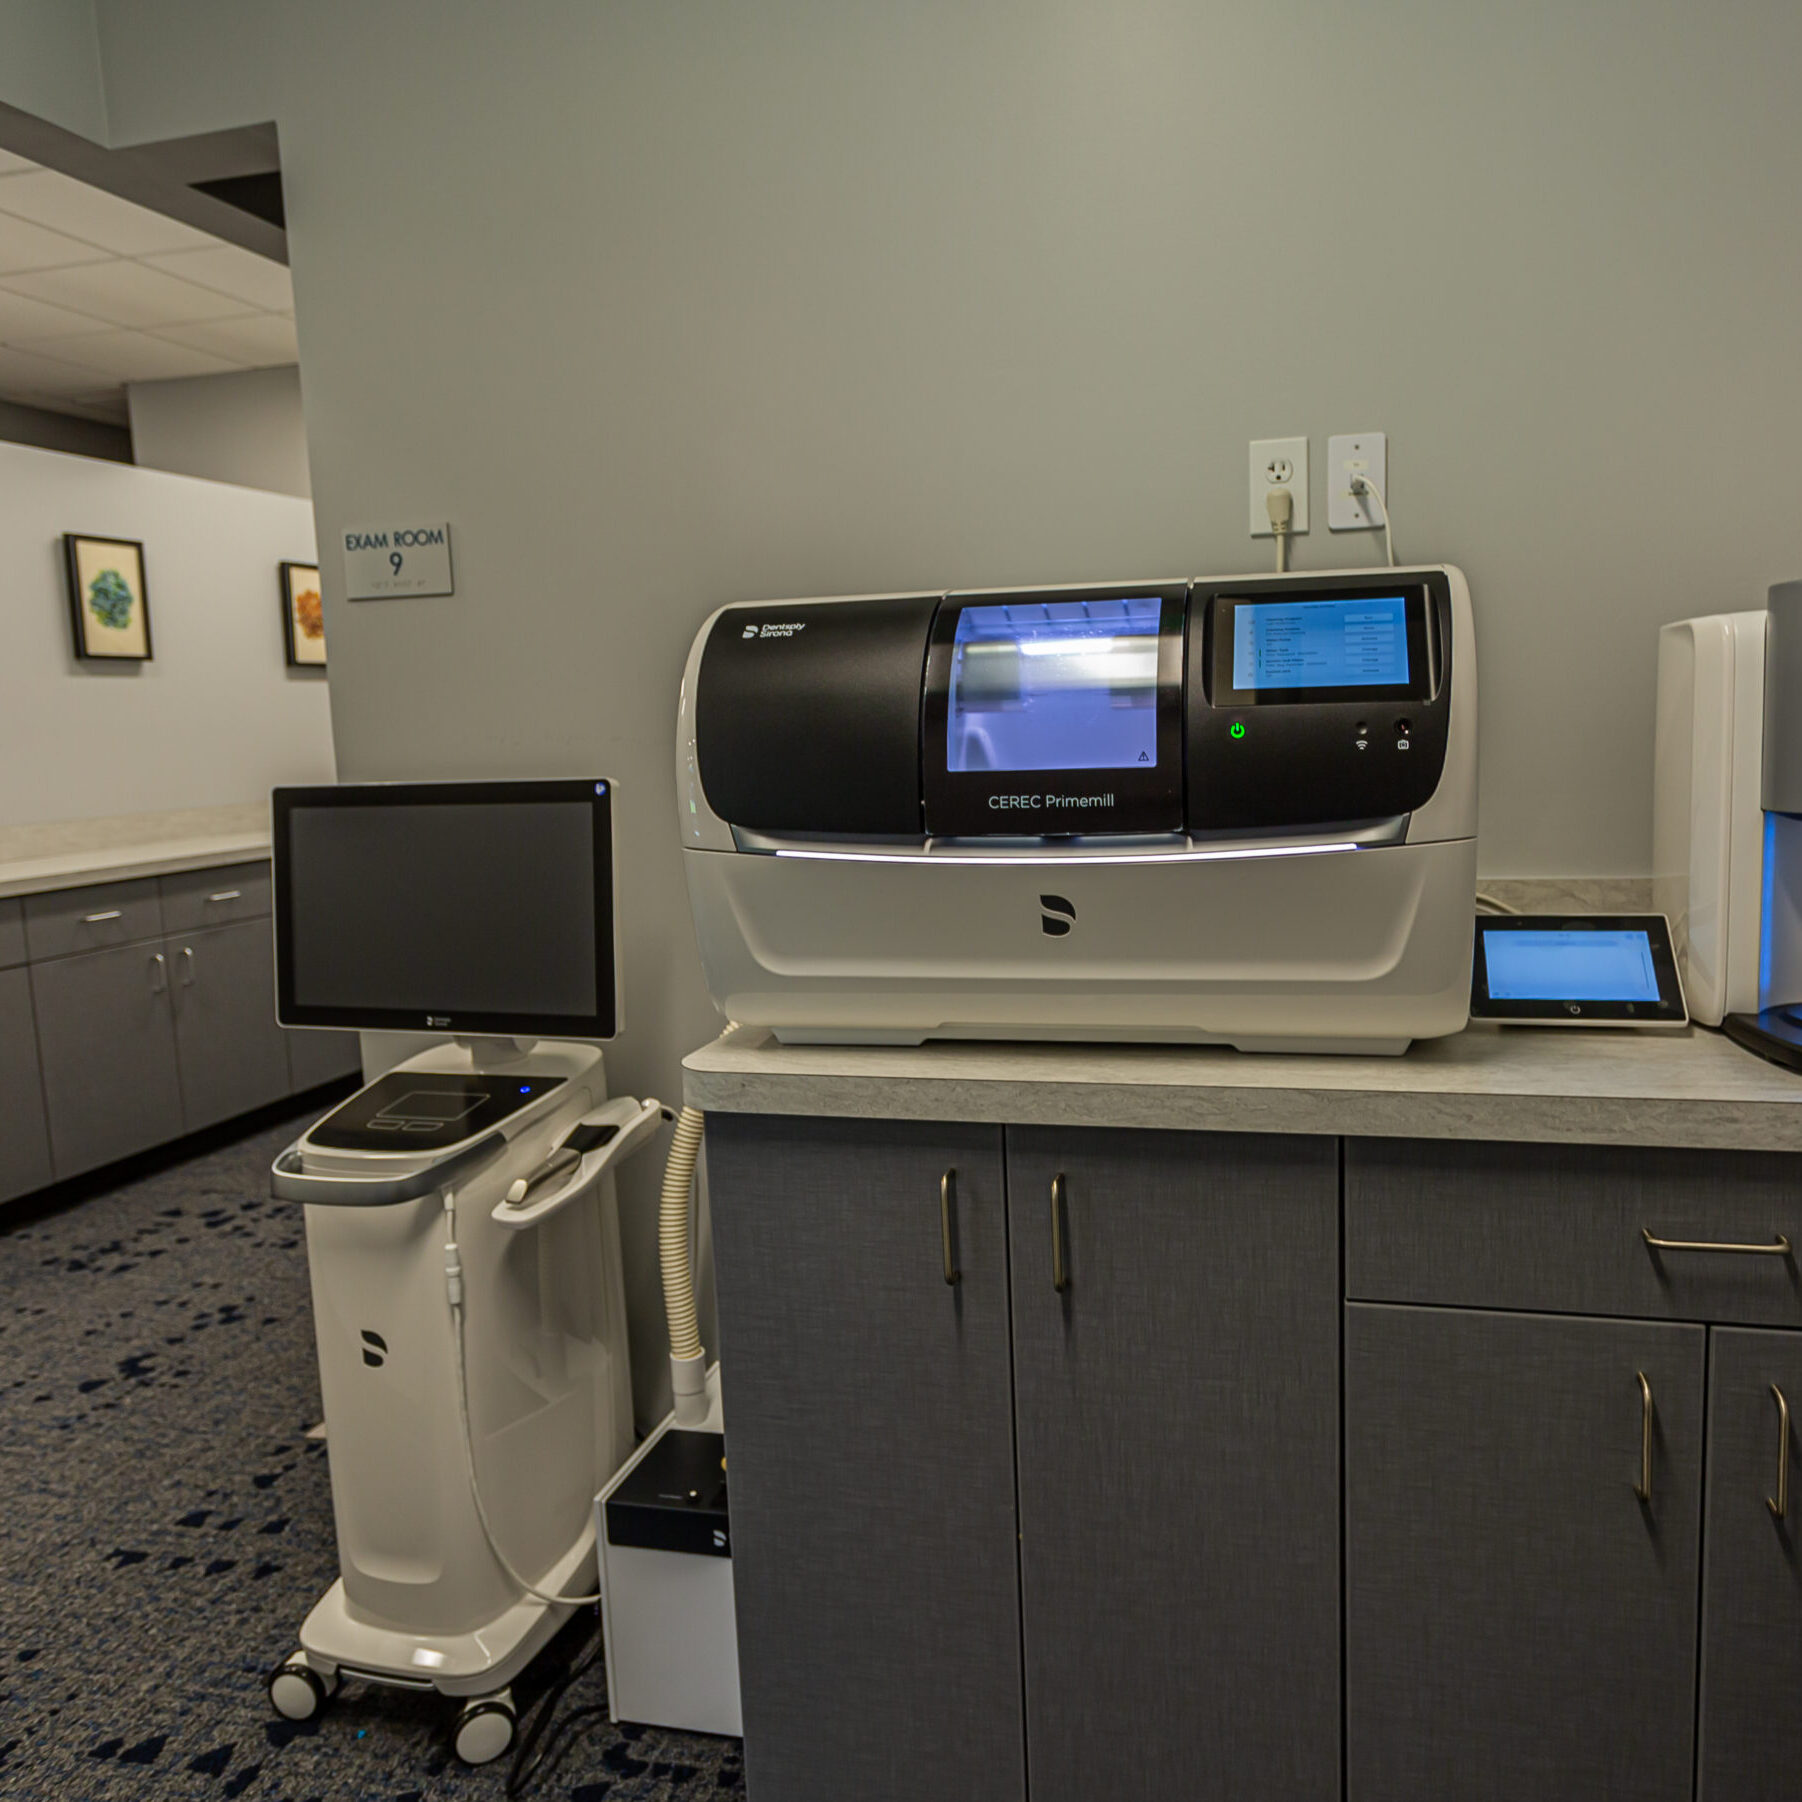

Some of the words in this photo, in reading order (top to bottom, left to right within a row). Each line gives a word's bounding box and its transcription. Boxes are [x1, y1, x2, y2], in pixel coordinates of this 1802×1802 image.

[345, 533, 389, 551] EXAM
[393, 529, 444, 548] ROOM
[389, 551, 403, 576] 9
[760, 630, 793, 638] Sirona
[762, 623, 806, 632] Dentsply
[988, 795, 1041, 809] CEREC
[1046, 793, 1115, 808] Primemill
